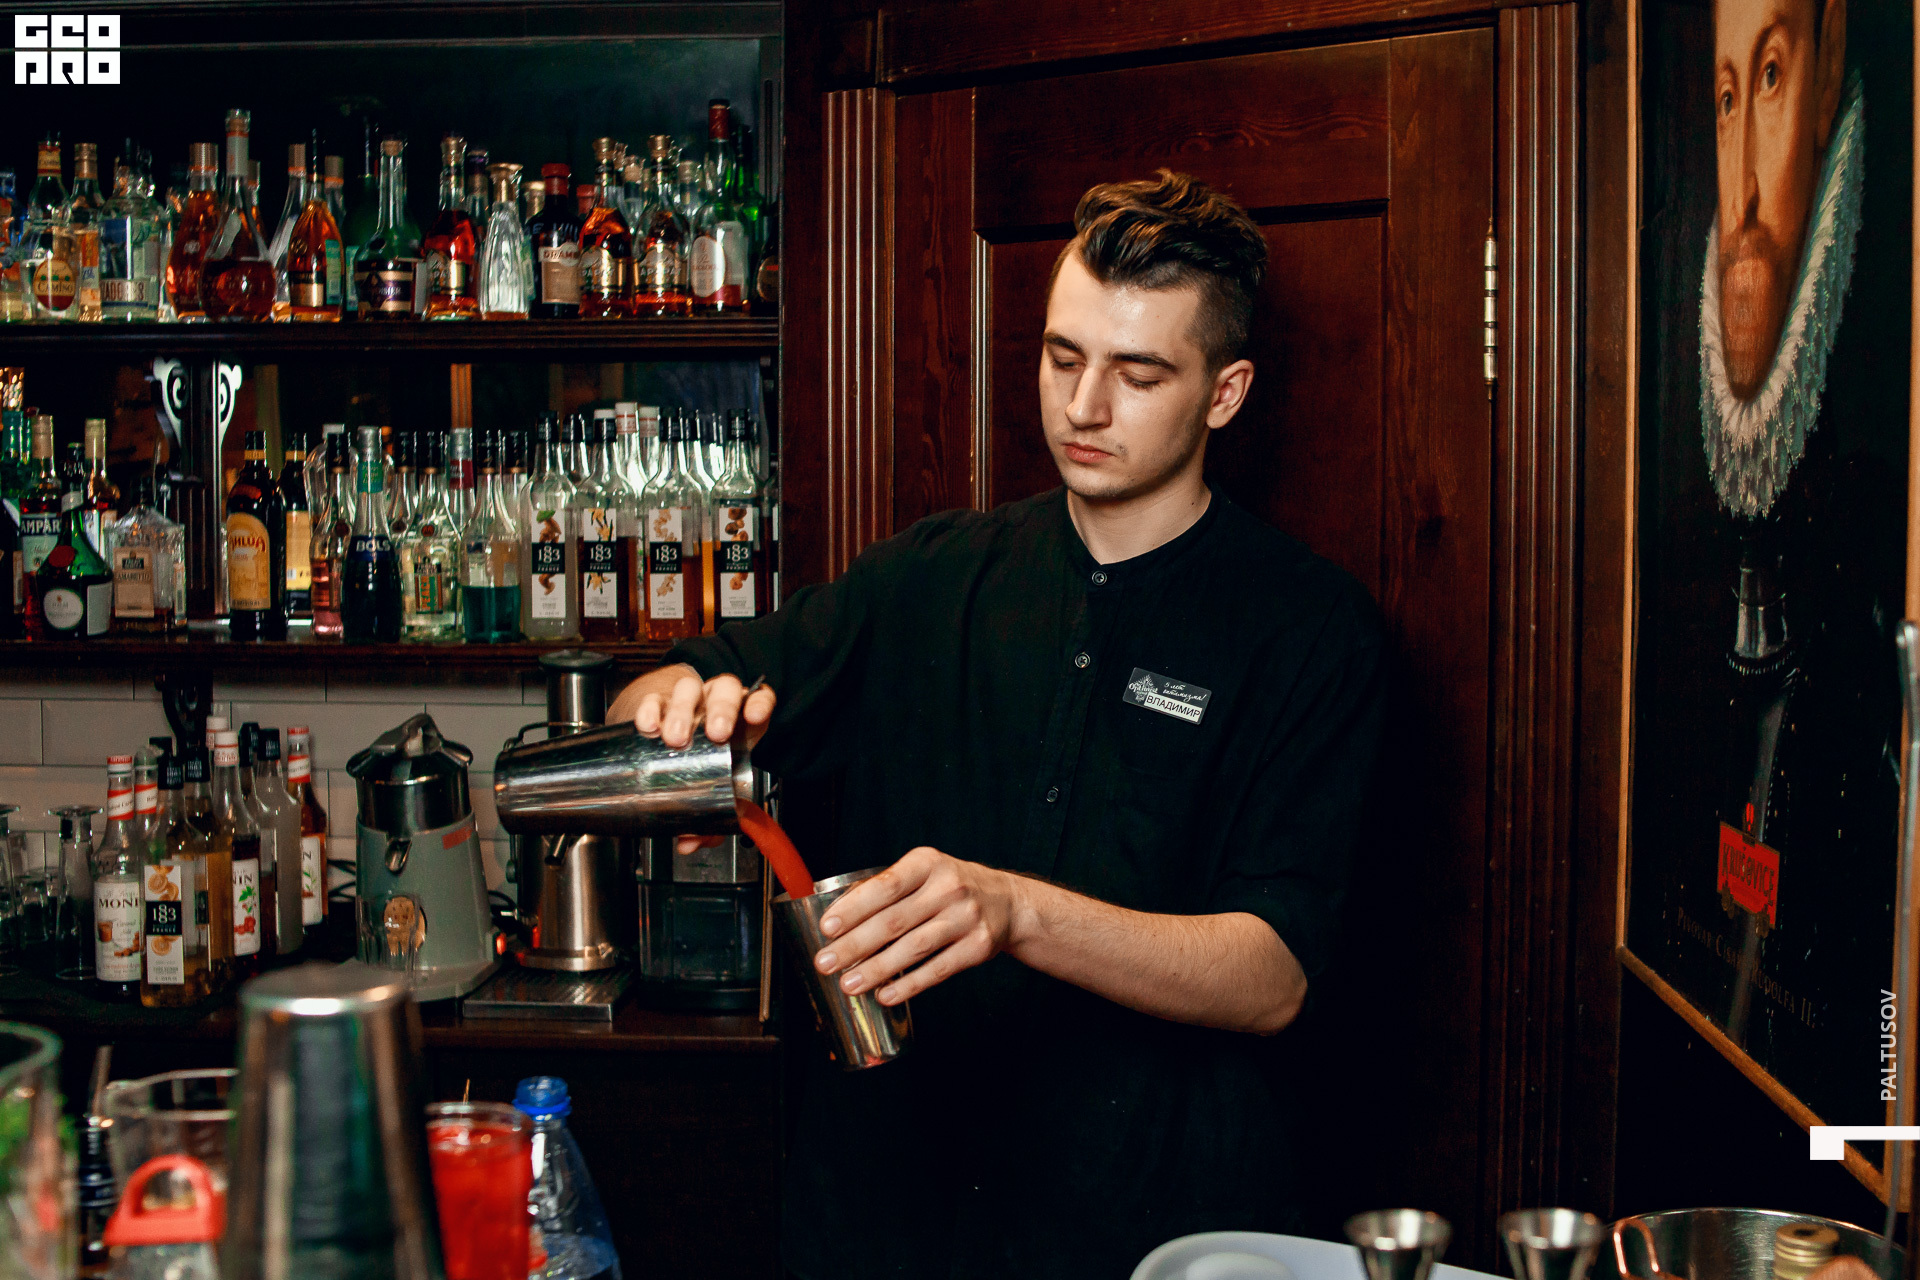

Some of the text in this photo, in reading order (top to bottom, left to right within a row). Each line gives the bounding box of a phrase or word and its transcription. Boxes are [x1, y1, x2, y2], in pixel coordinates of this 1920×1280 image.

[20, 519, 60, 534] AMPAR
[355, 540, 391, 552] BOLS
[1146, 695, 1201, 718] ВЛАДИМИР
[98, 898, 138, 908] MONI
